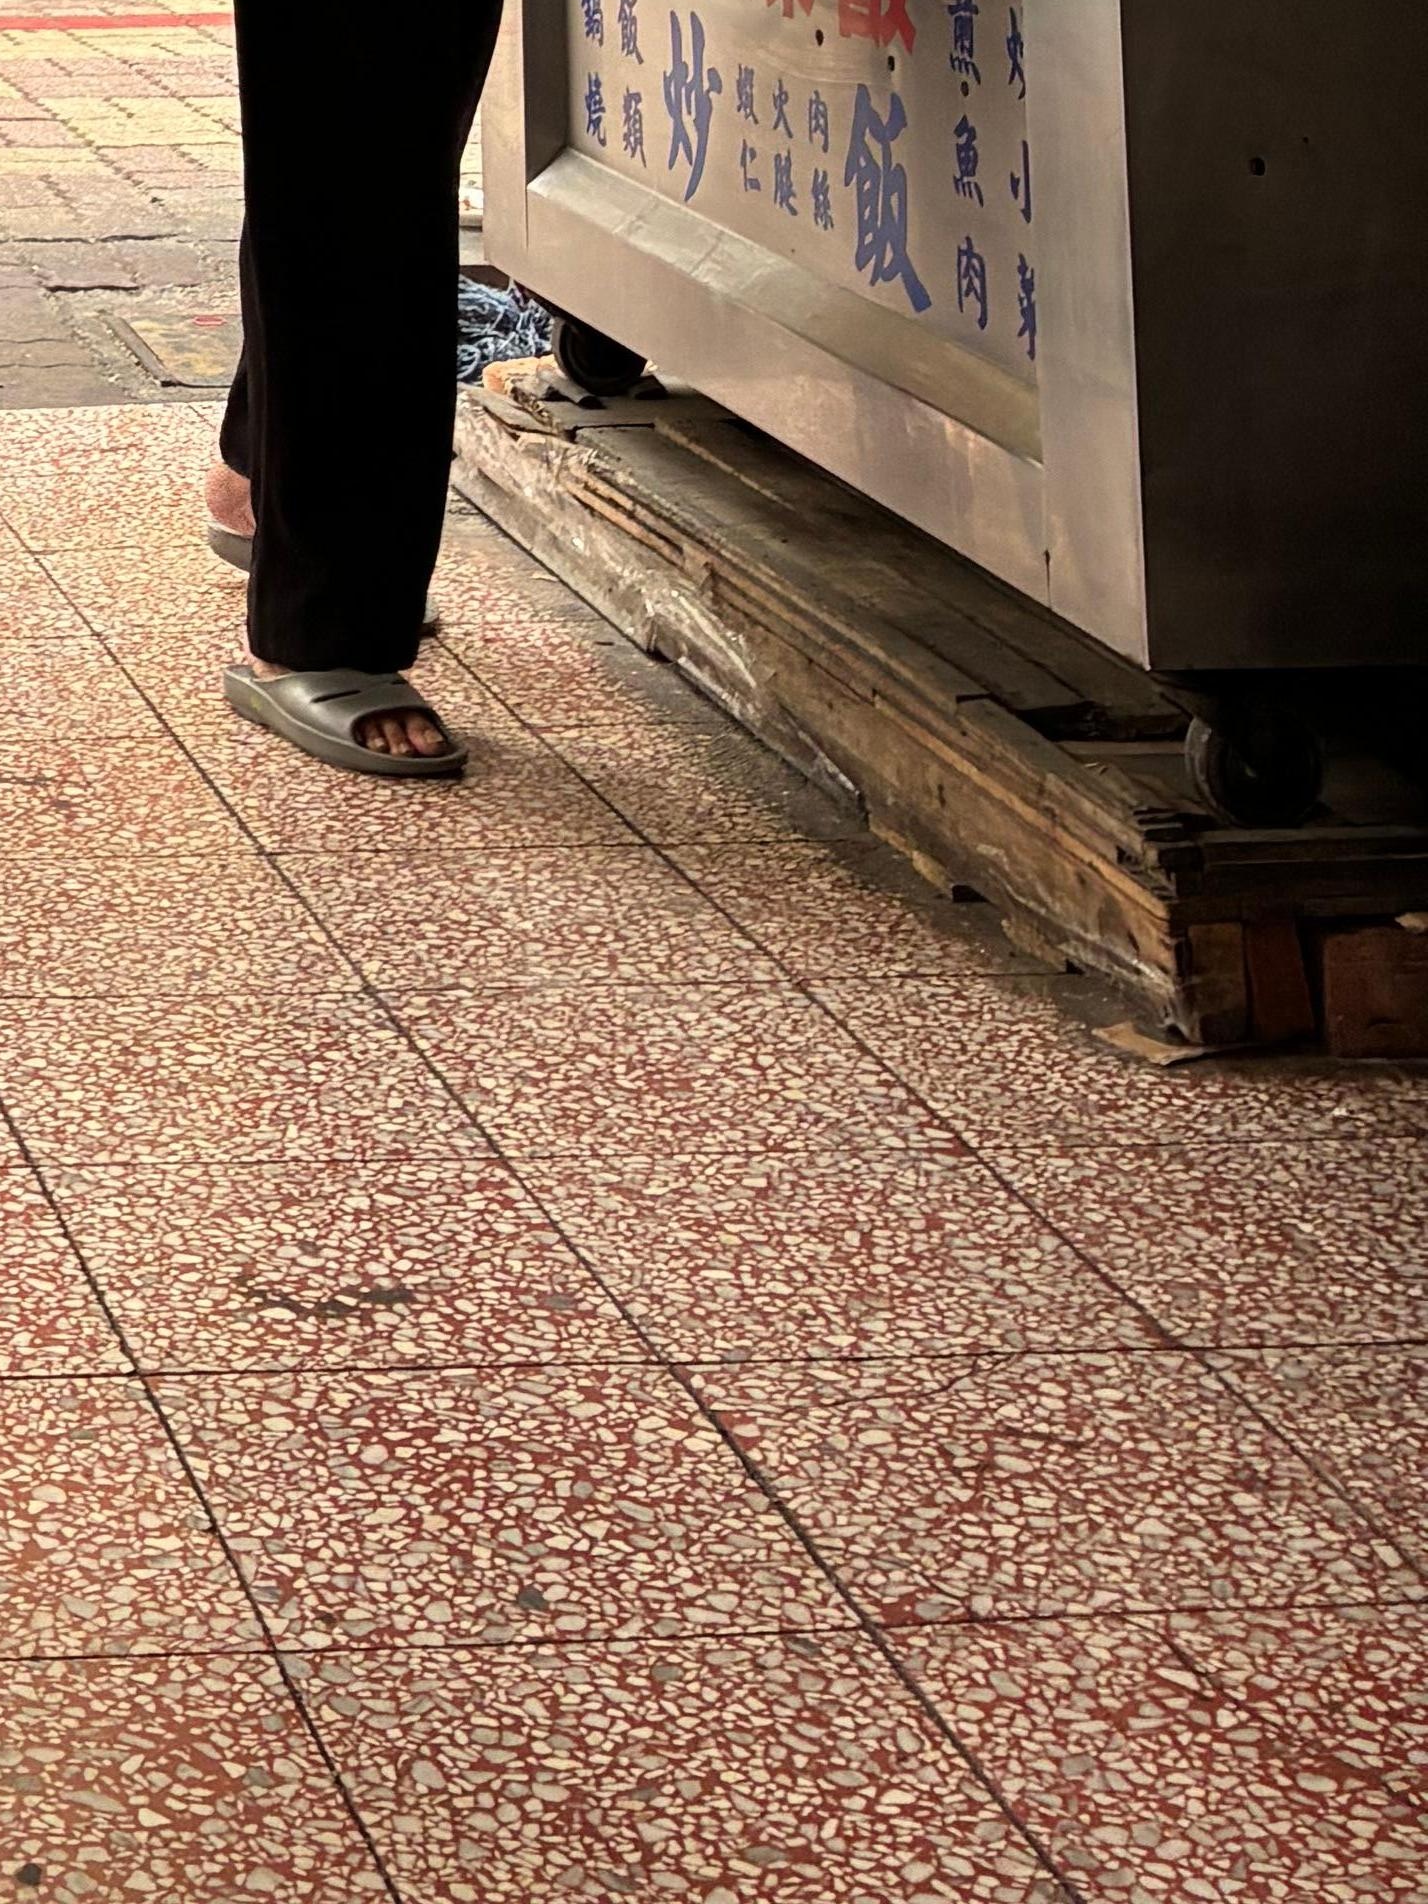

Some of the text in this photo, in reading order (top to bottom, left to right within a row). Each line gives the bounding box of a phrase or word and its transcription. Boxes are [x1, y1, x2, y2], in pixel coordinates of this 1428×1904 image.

[663, 9, 932, 313] 炒 飯
[736, 63, 762, 192] 蝦仁
[772, 78, 799, 217] 火腿
[809, 90, 835, 232] 肉絲
